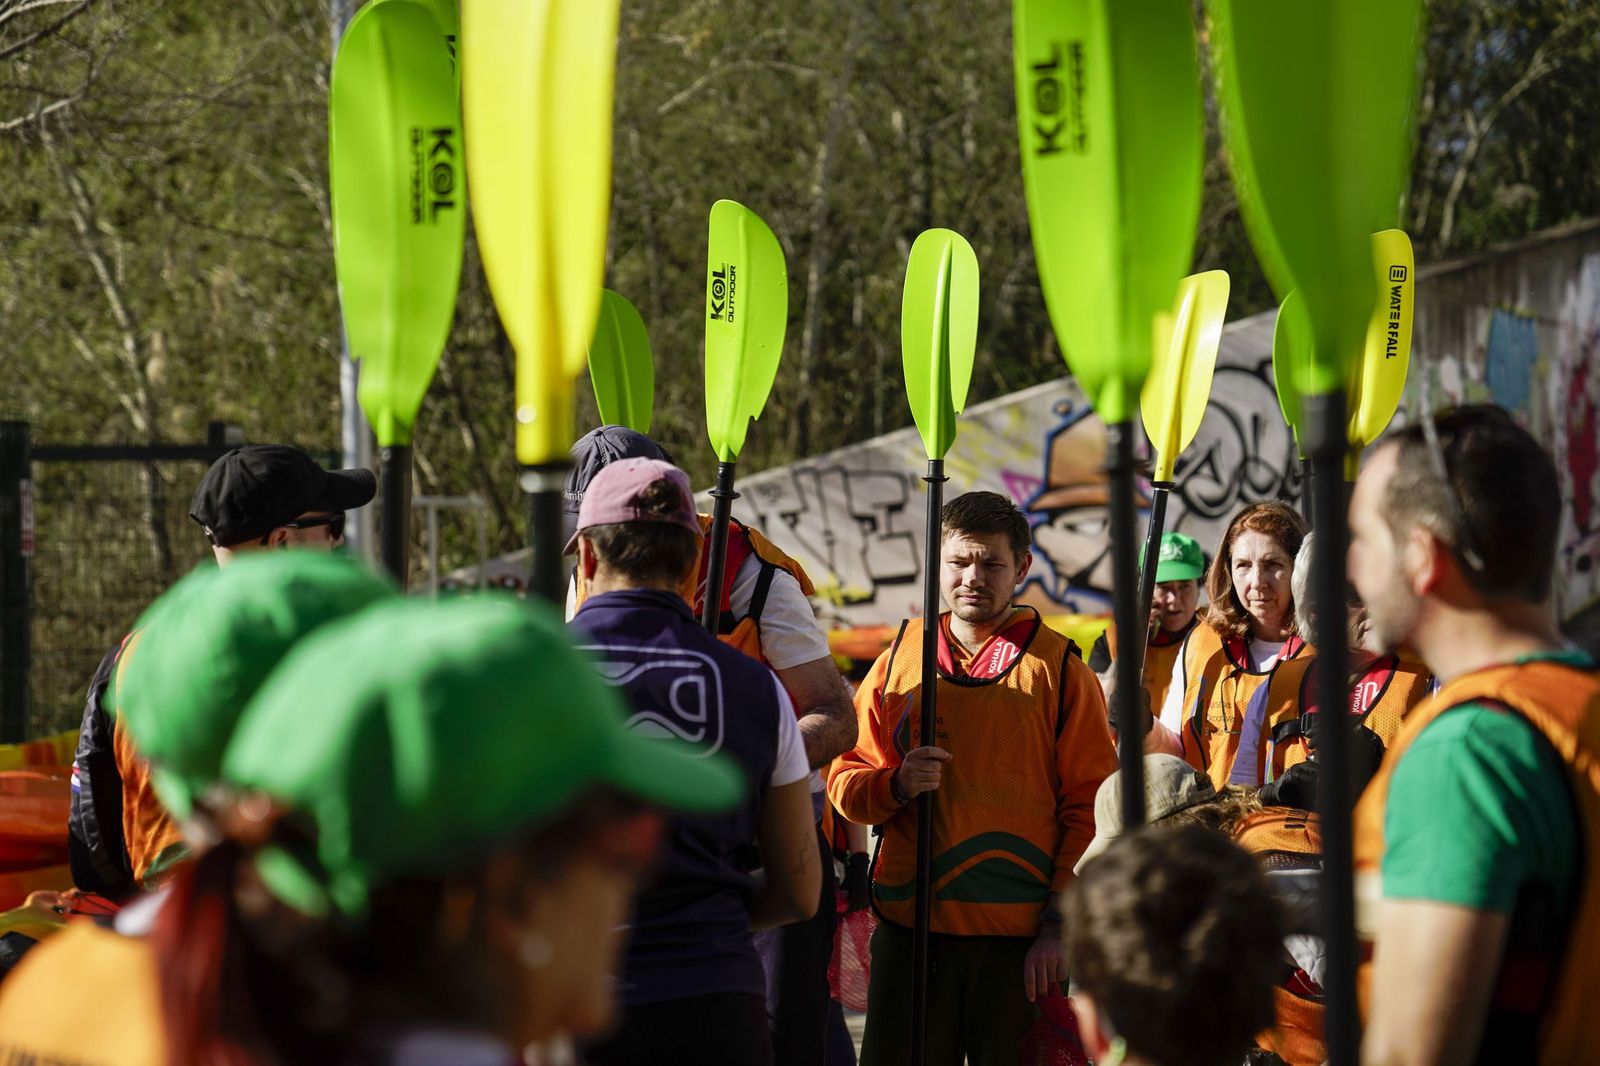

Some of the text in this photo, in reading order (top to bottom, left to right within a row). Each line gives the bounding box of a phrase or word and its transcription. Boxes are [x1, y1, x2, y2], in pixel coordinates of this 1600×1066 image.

[429, 126, 455, 224] KOL
[710, 262, 726, 320] KOL
[728, 265, 736, 323] OUTDOOR
[1385, 285, 1402, 359] WATERFALL
[987, 641, 1003, 674] KOHALA
[1352, 682, 1364, 713] KOHALA
